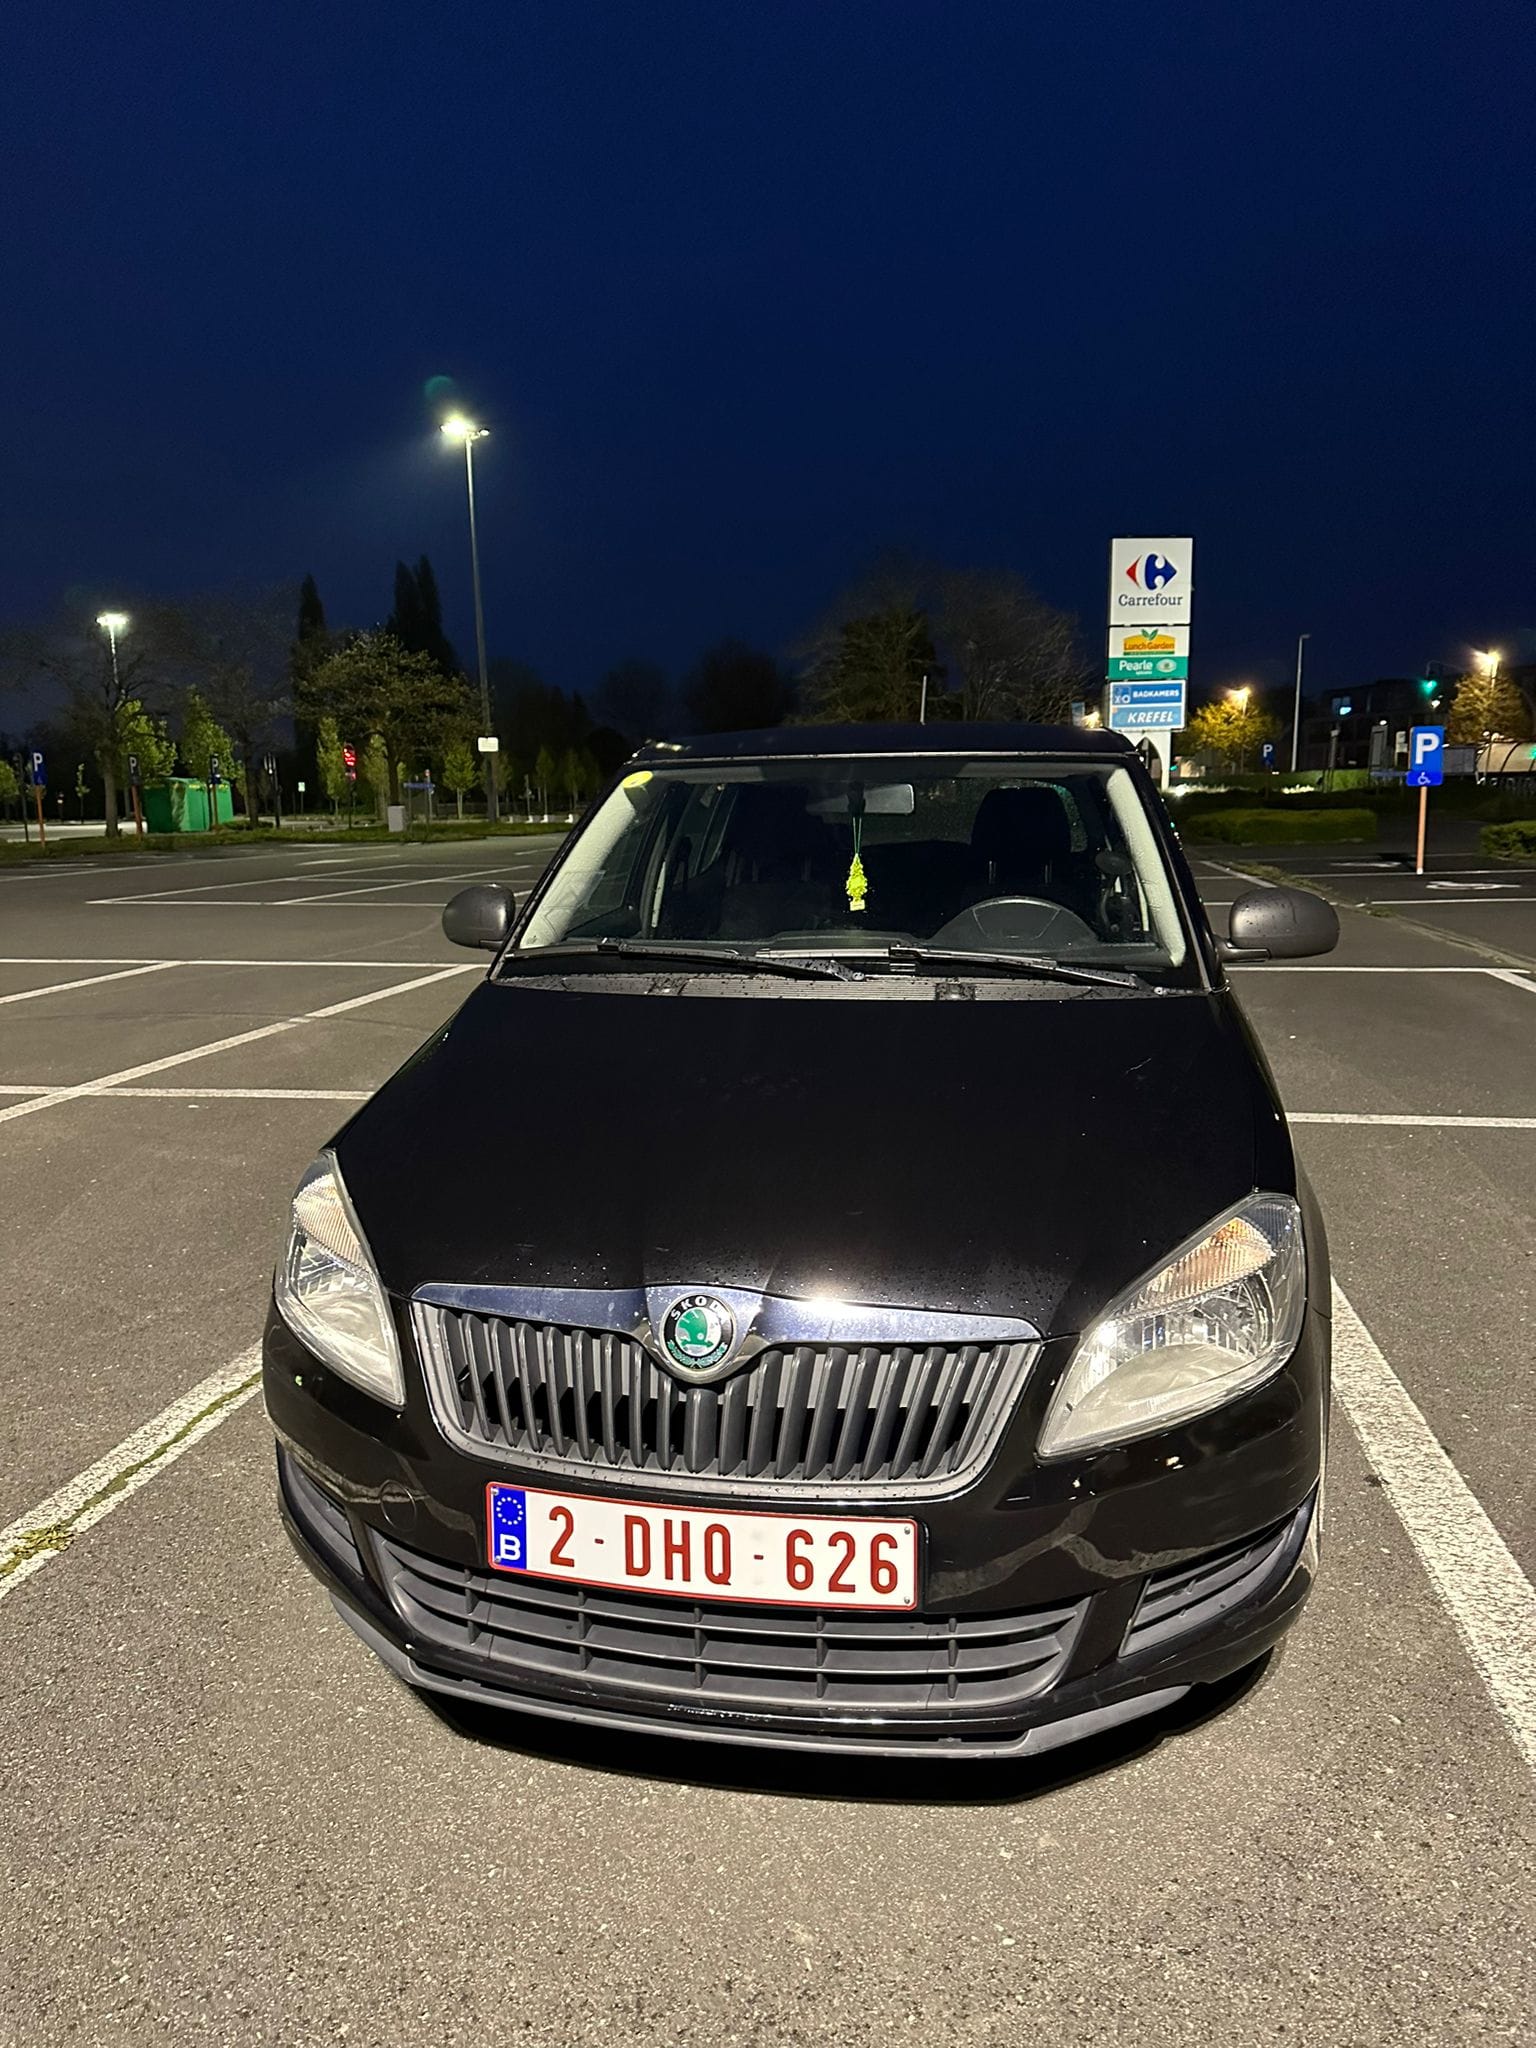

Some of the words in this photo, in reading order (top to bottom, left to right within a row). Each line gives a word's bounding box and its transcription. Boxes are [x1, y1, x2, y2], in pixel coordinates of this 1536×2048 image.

[1118, 593, 1183, 607] Carrefour
[1119, 660, 1153, 672] Pearle
[1132, 689, 1180, 699] BADKAMERS
[1127, 711, 1174, 724] KREFEL
[1263, 744, 1273, 758] P
[1414, 732, 1440, 765] P
[33, 752, 43, 771] P
[129, 756, 137, 773] P
[211, 757, 219, 773] P
[499, 1533, 521, 1562] B
